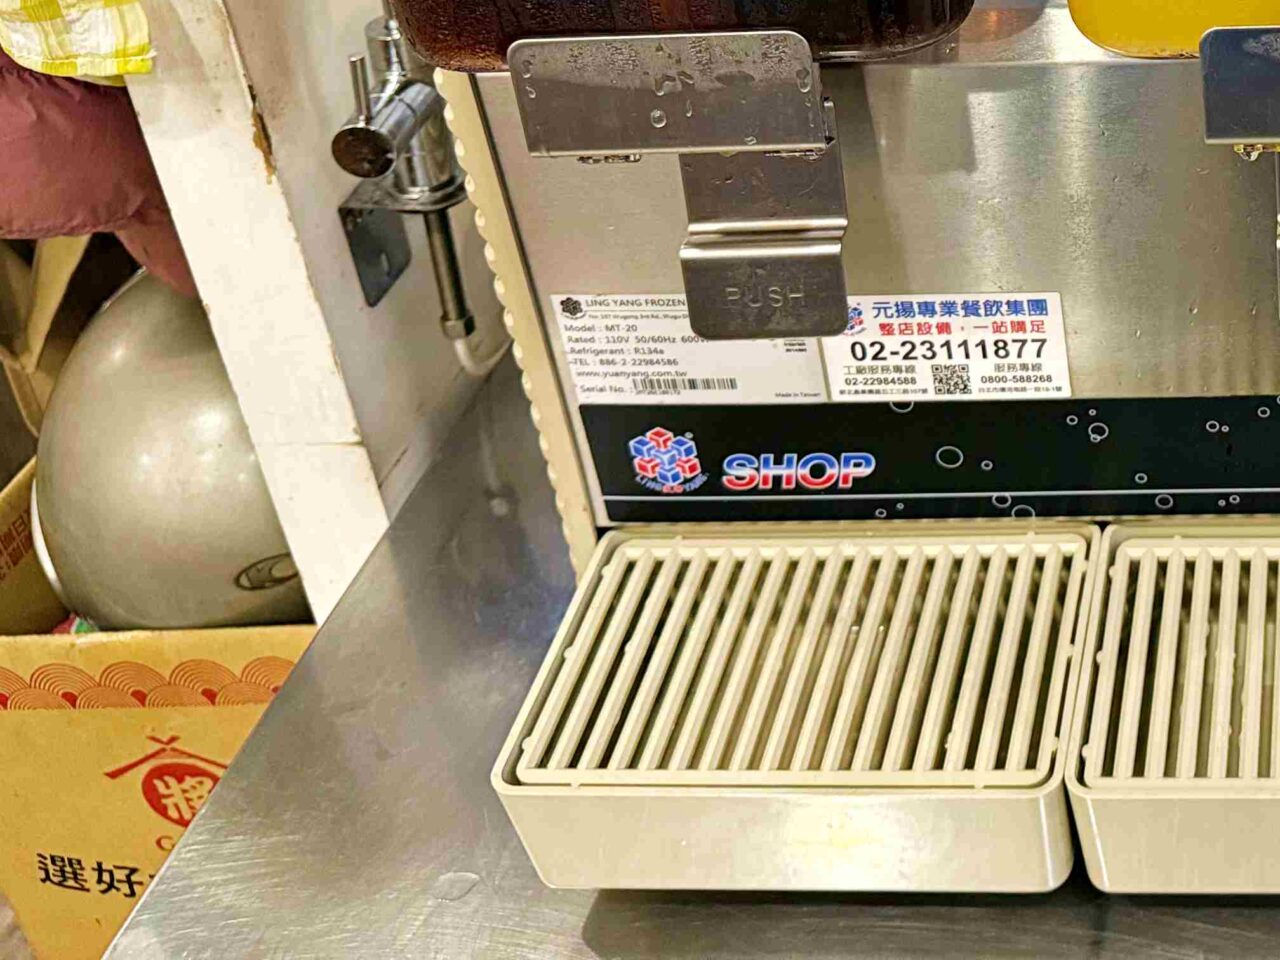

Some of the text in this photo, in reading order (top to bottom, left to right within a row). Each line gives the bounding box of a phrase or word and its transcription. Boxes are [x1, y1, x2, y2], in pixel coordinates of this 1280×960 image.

[725, 286, 804, 308] PUSH
[585, 298, 686, 307] LING YANG FROZEN
[872, 298, 1049, 319] 元揚專業餐飲集團
[564, 324, 595, 332] Model
[605, 324, 637, 332] MT-20
[635, 335, 676, 344] 50/60Hz
[569, 346, 624, 356] Refrigerant
[634, 347, 664, 355] R134a
[850, 338, 1048, 362] 02-23111877
[576, 370, 687, 379] www.yuanyang.com.tw
[980, 374, 1053, 383] 0800-588268
[580, 384, 606, 392] Serial
[722, 452, 876, 489] SHOP
[36, 852, 157, 898] 選好
